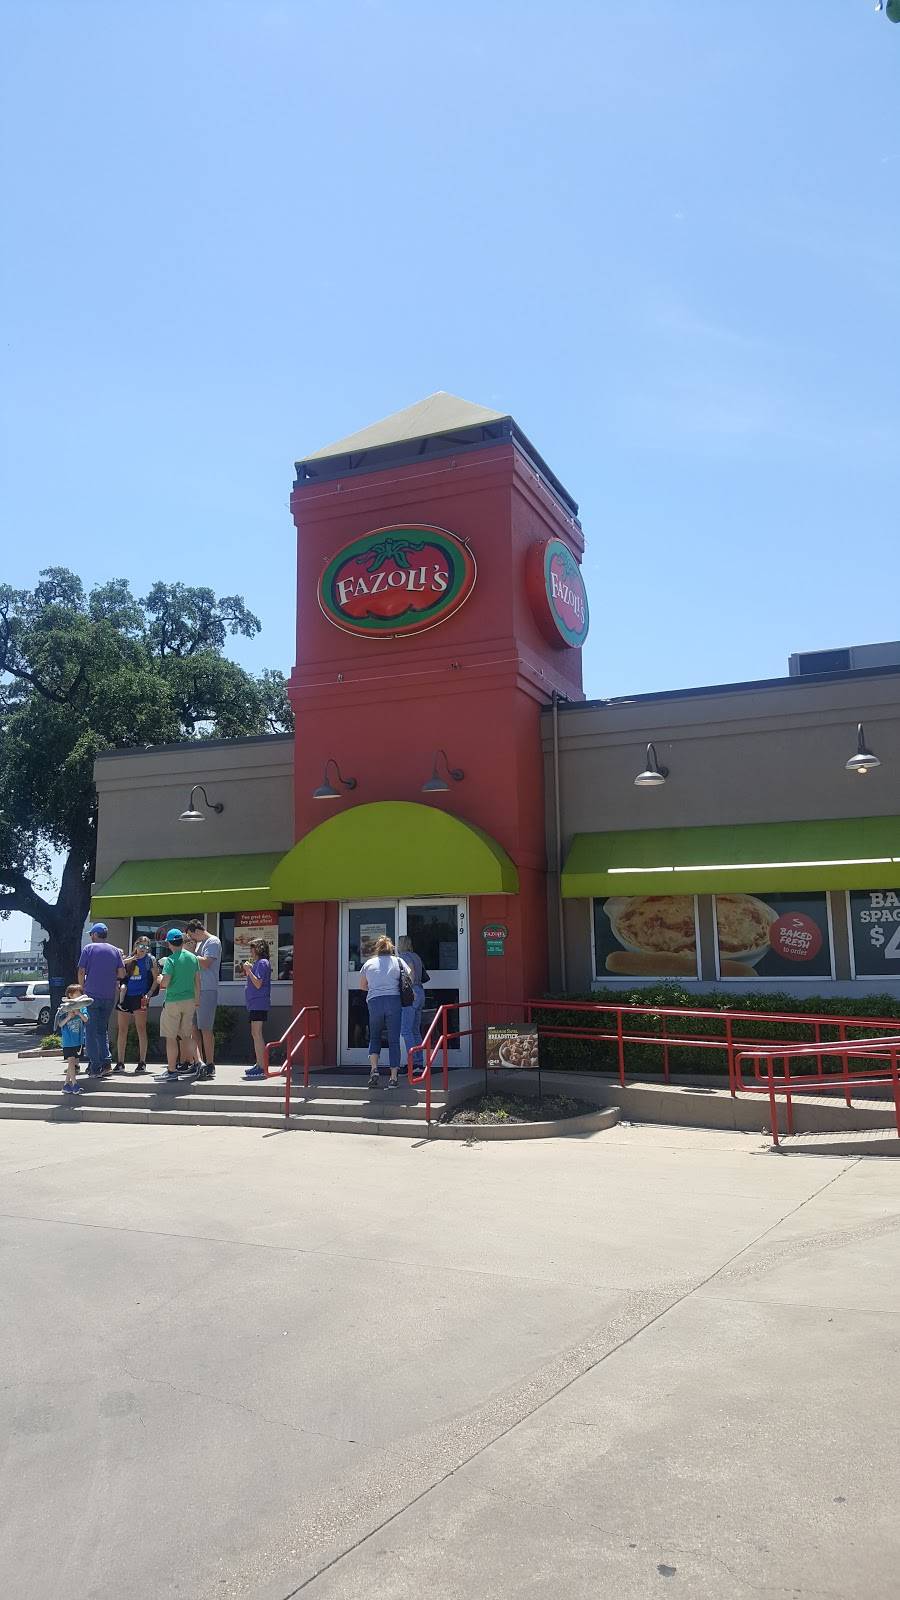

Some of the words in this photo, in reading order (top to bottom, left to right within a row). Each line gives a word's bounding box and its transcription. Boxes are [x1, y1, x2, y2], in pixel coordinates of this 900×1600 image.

[335, 564, 449, 606] FAZOLI'S
[550, 571, 585, 625] FAZOLI'S
[780, 927, 813, 941] BAKED
[780, 936, 811, 949] FRESH
[790, 948, 808, 956] order
